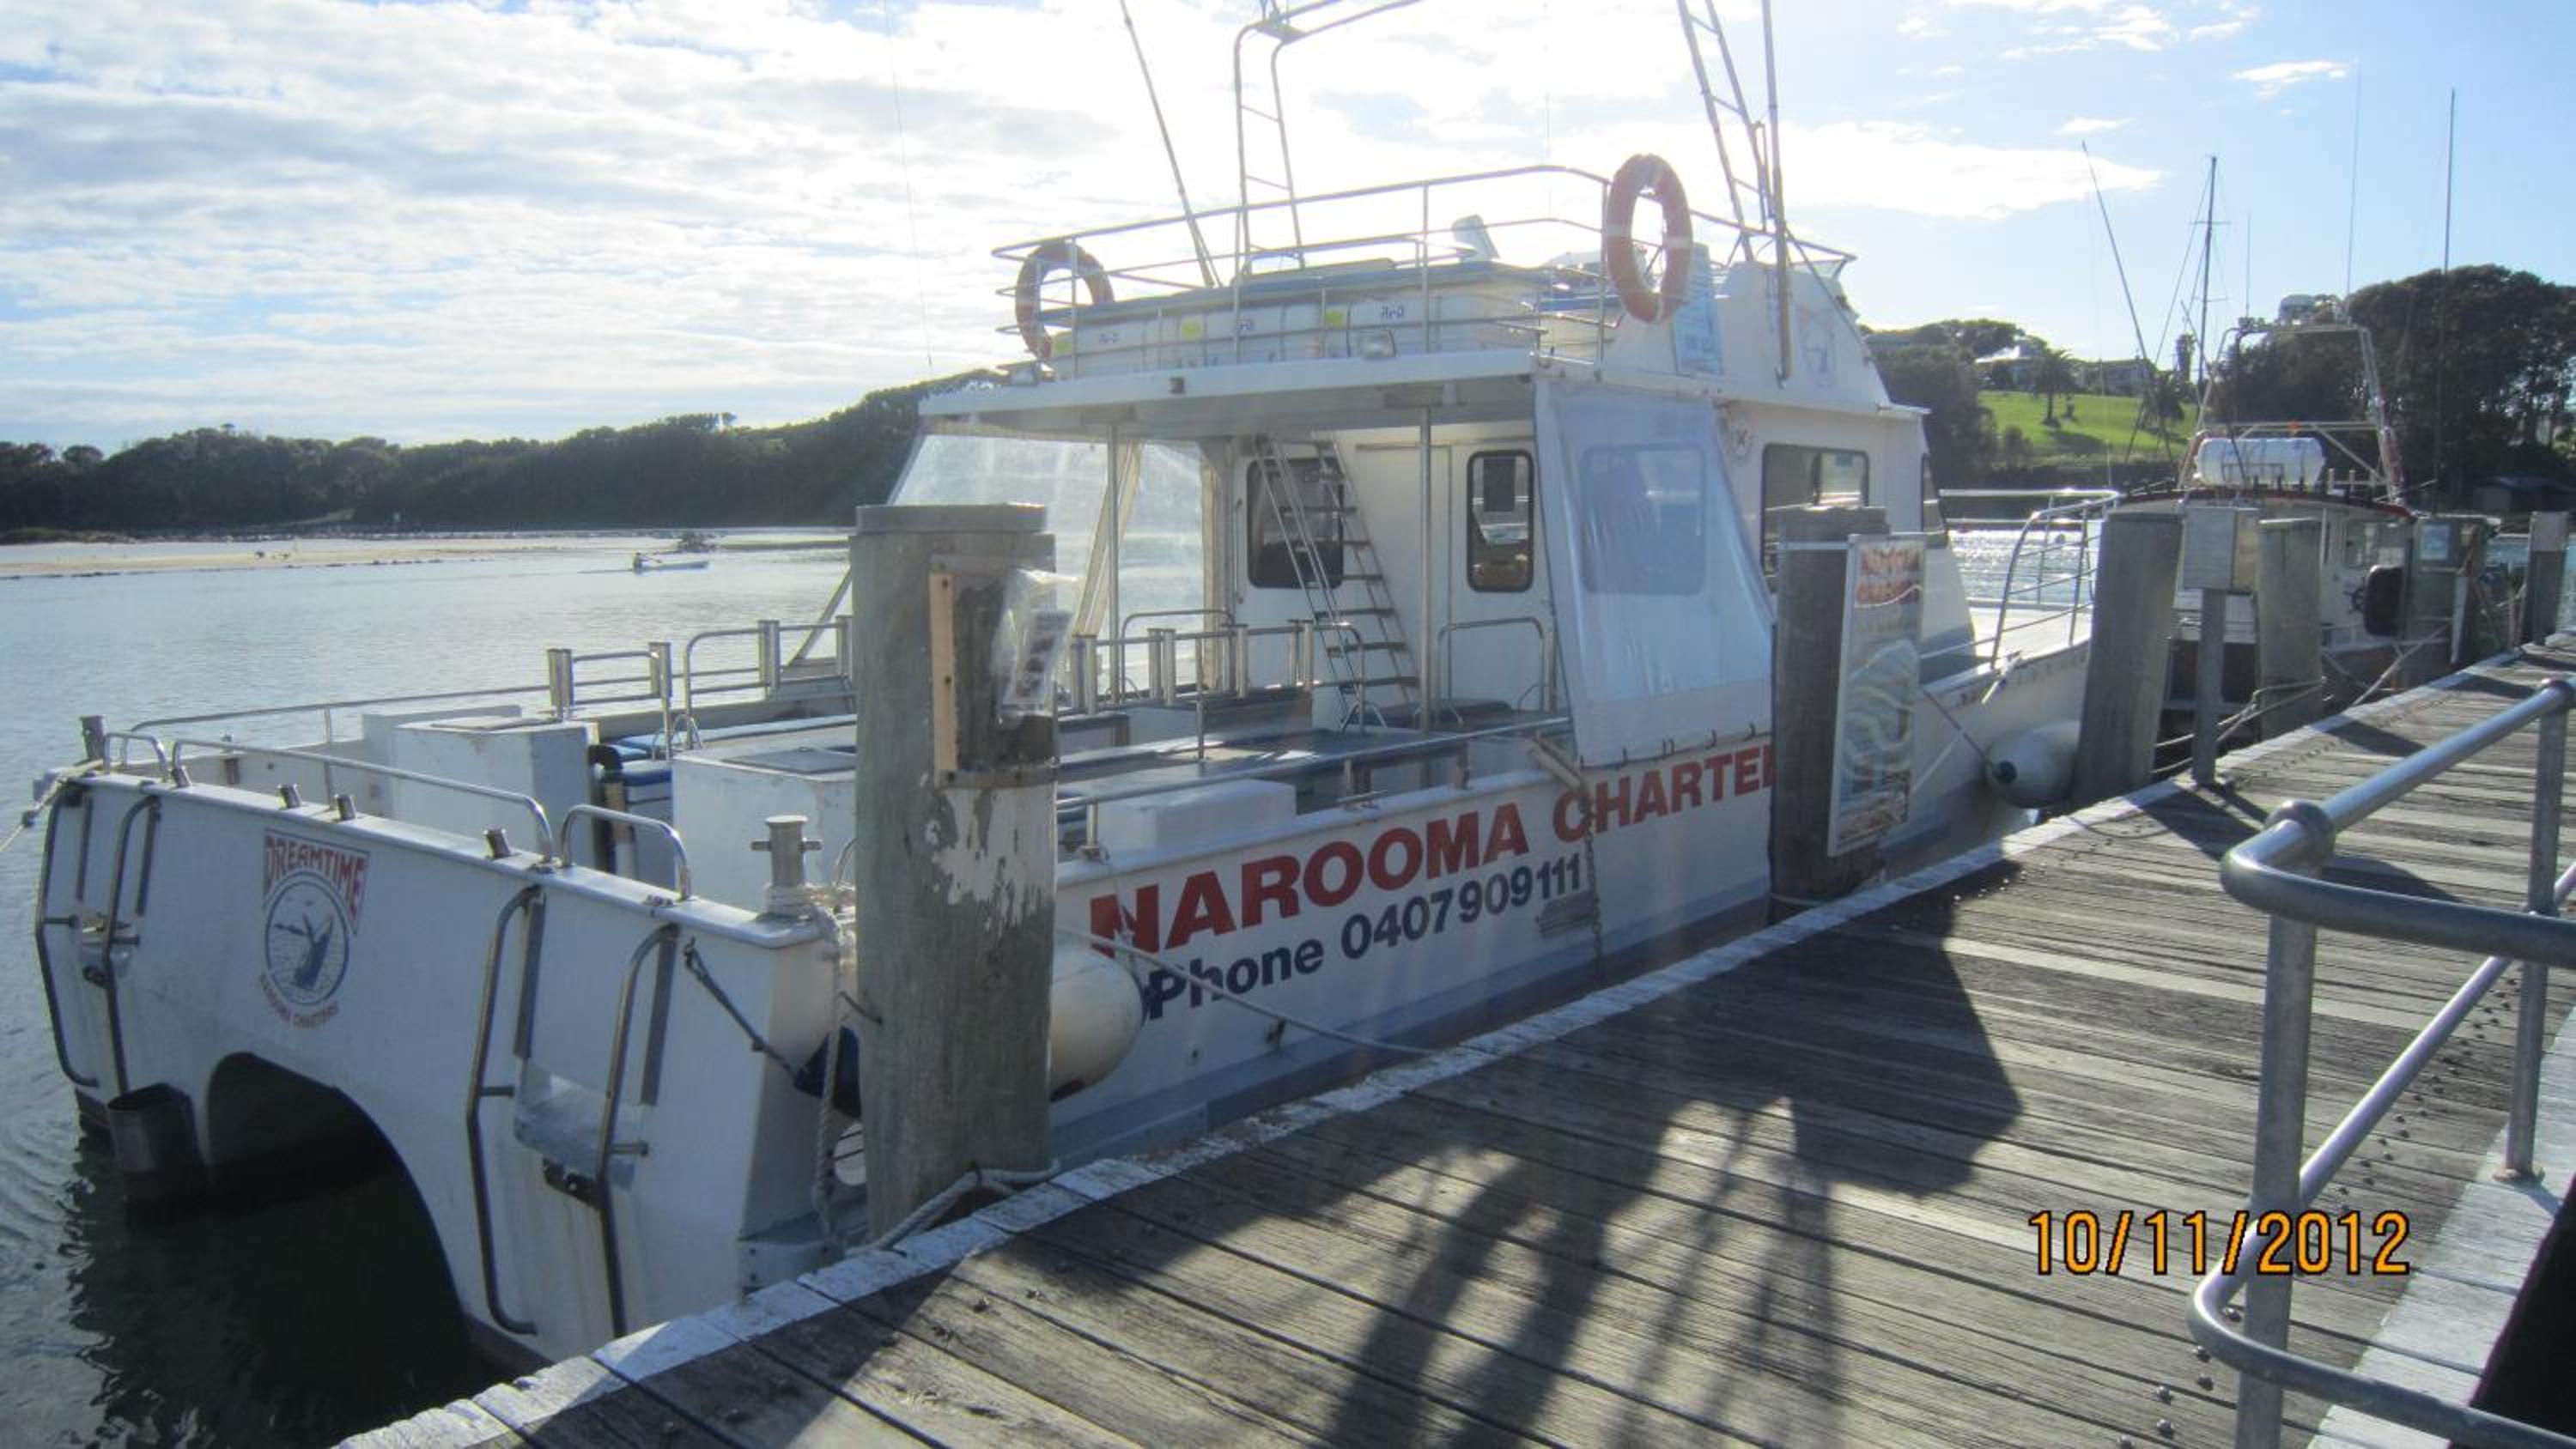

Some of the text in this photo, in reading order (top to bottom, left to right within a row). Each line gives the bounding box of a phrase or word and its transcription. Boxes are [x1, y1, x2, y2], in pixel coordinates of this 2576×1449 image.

[263, 833, 368, 925] DREAMTIME
[1090, 803, 1529, 959] NAROOMA
[1146, 852, 1580, 1022] Phone 0407909111
